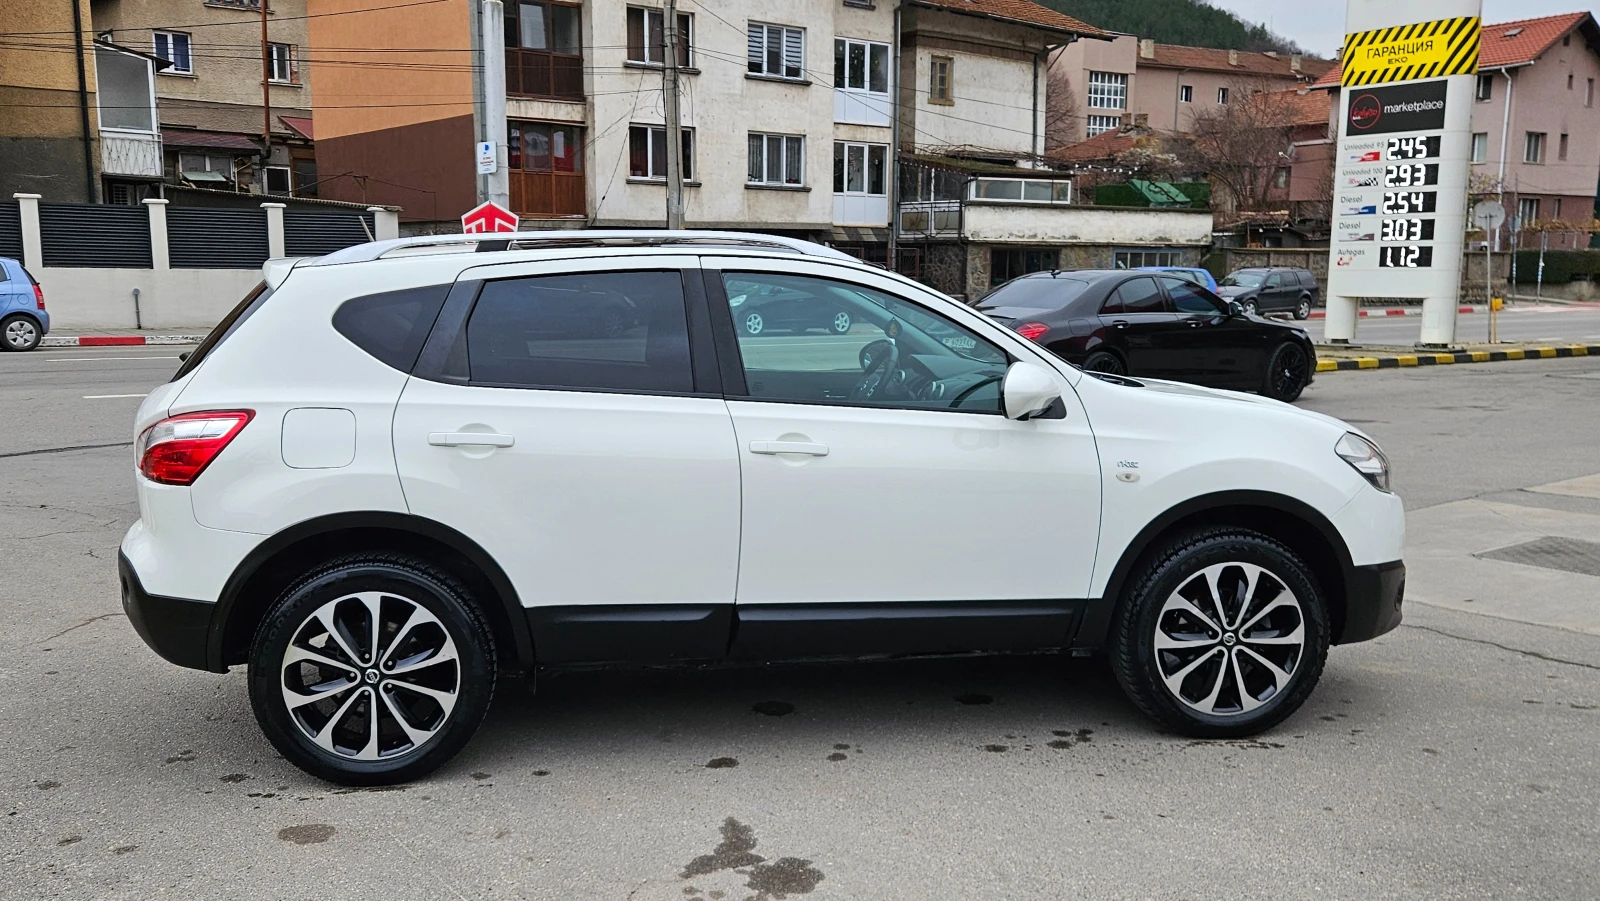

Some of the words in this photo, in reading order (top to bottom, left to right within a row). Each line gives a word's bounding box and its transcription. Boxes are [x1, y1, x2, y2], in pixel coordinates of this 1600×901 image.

[1366, 40, 1433, 59] ГАРАНЦИЯ
[1387, 56, 1408, 65] EKO
[1383, 99, 1444, 114] marketplace
[1344, 142, 1374, 151] Unleaded
[1376, 141, 1385, 149] 95
[1386, 136, 1427, 160] 2.45
[1342, 168, 1371, 176] Unleaded
[1372, 167, 1384, 175] 100
[1384, 163, 1426, 187] 2.93
[1340, 195, 1363, 204] Diesel
[1382, 191, 1424, 214] 2.54
[1338, 222, 1361, 230] Diesel
[1382, 218, 1422, 241] 3.03
[1337, 248, 1366, 256] Autogas
